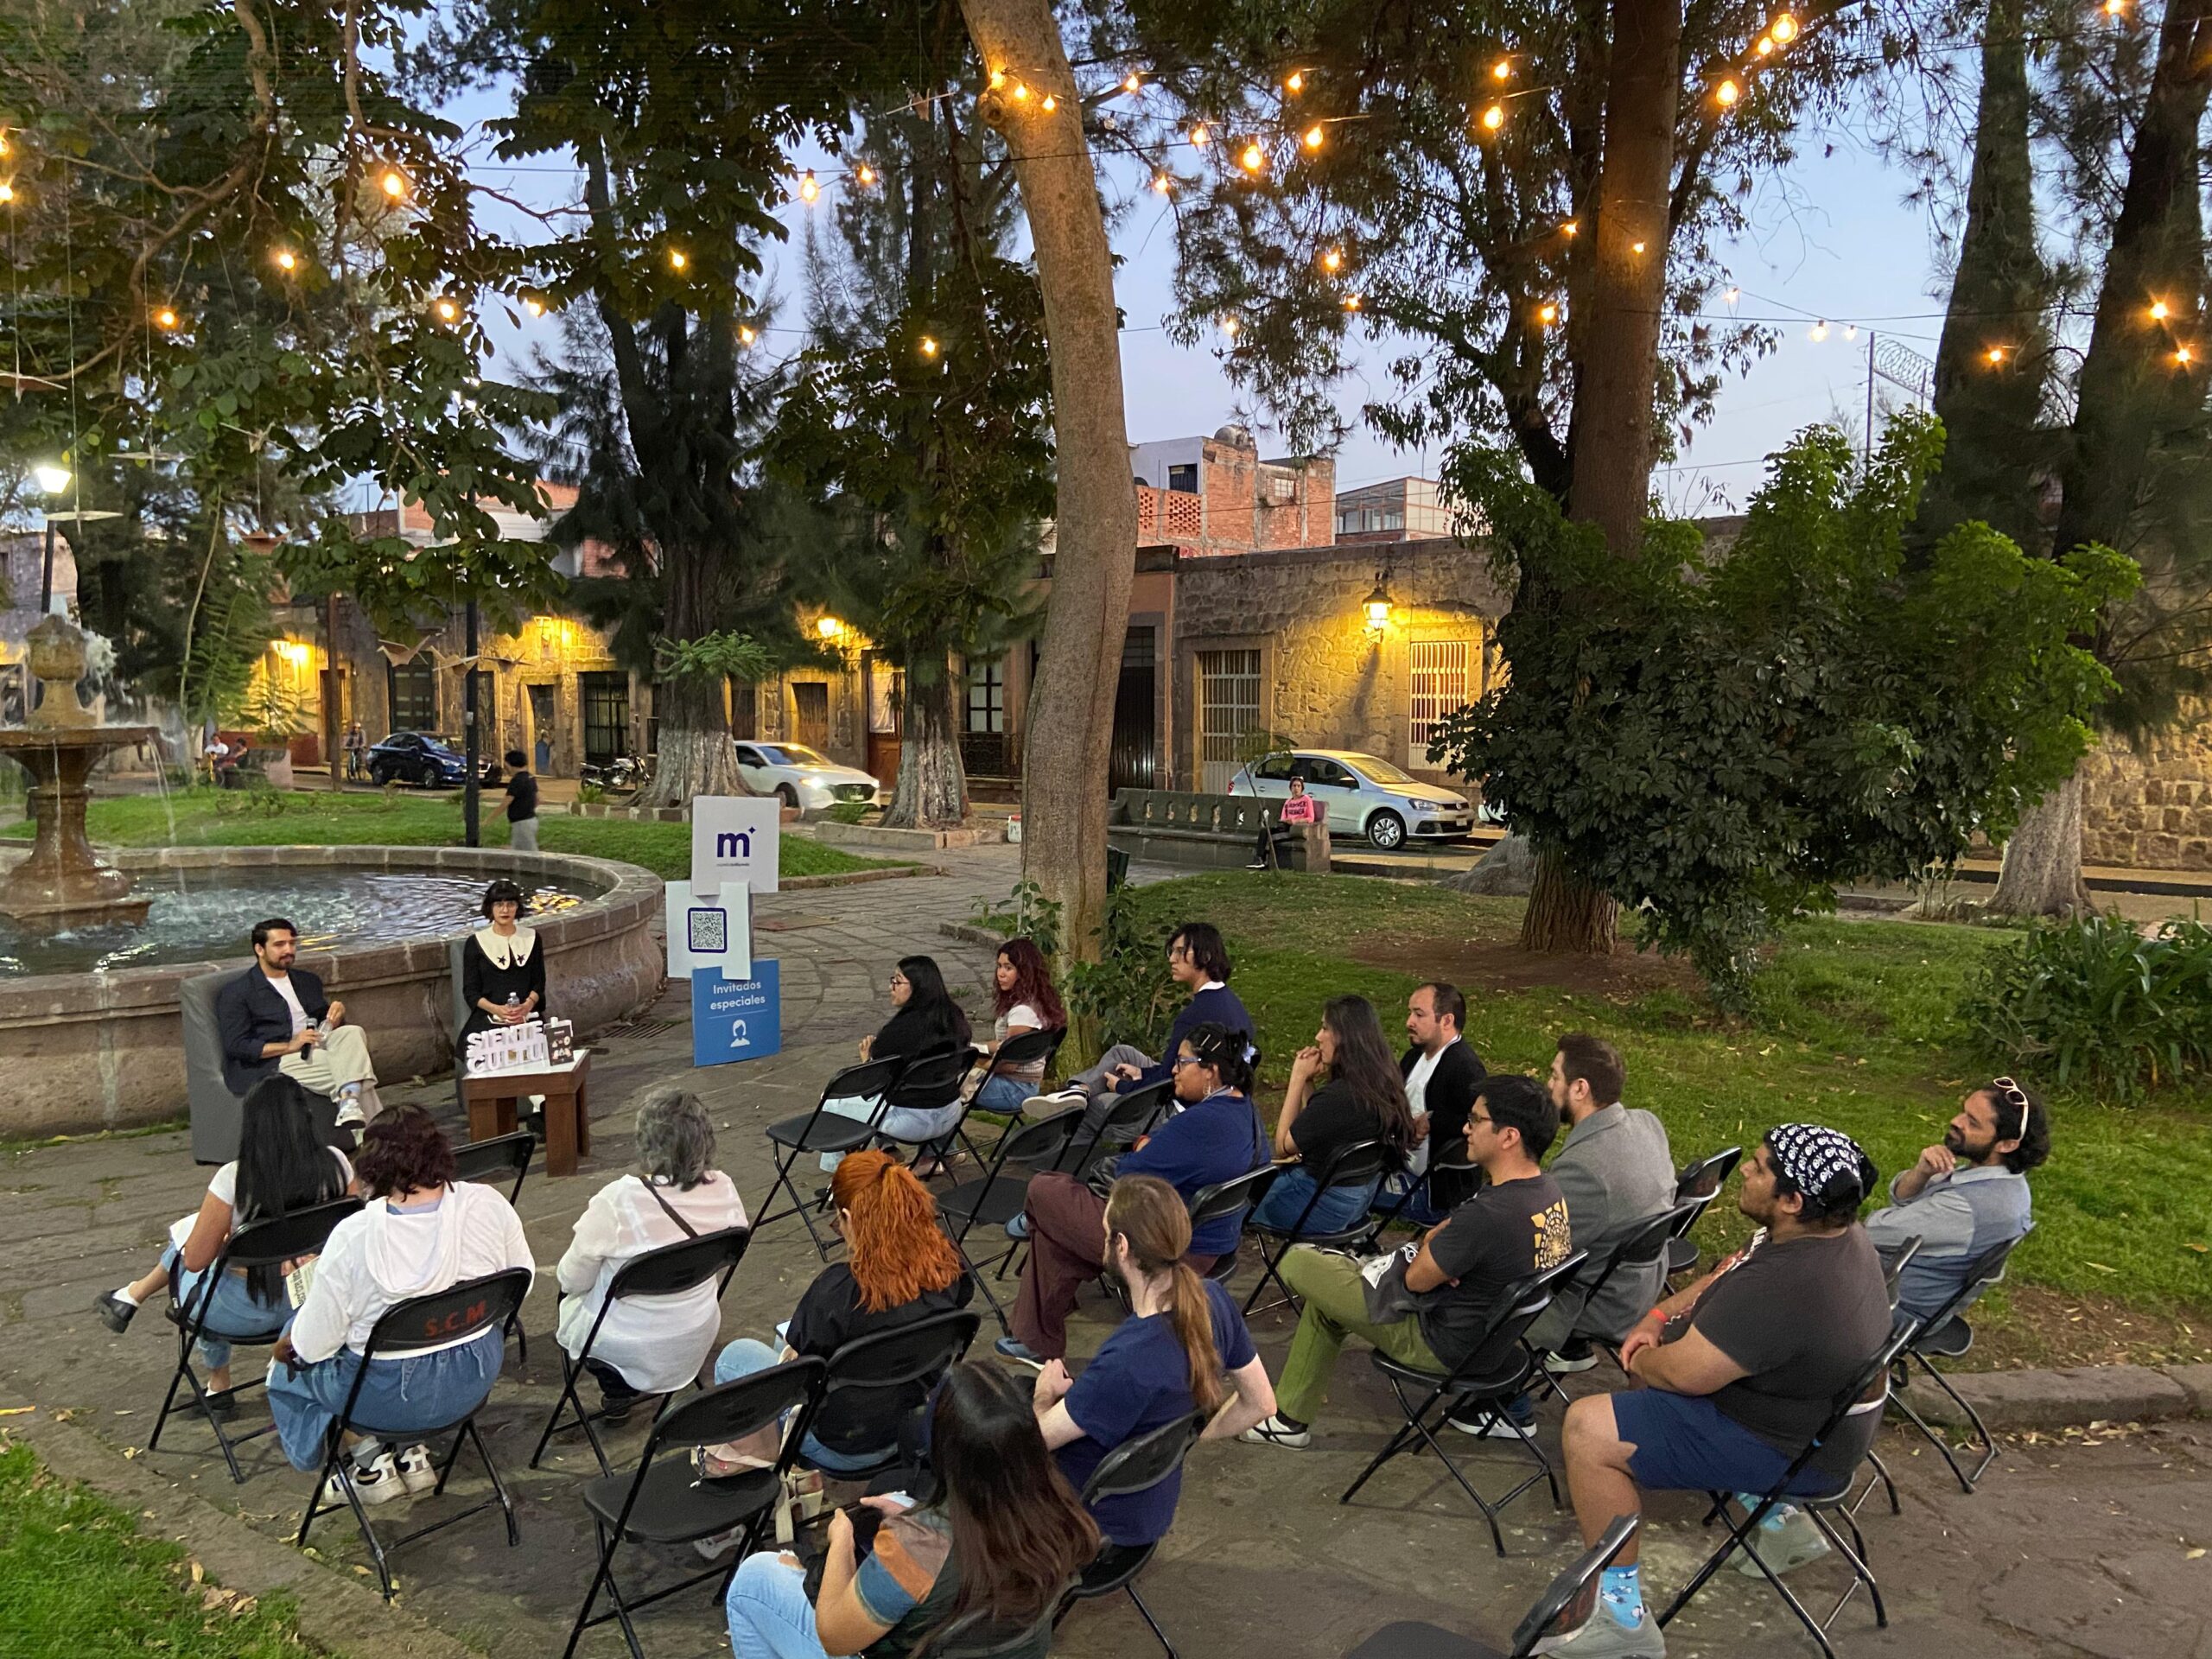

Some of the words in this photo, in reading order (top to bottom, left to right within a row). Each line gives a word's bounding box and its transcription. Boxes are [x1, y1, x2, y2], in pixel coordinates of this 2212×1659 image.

[713, 982, 761, 995] Invitados
[710, 995, 766, 1011] especiales
[467, 1020, 543, 1049] SIENTE
[467, 1041, 546, 1073] CULTU
